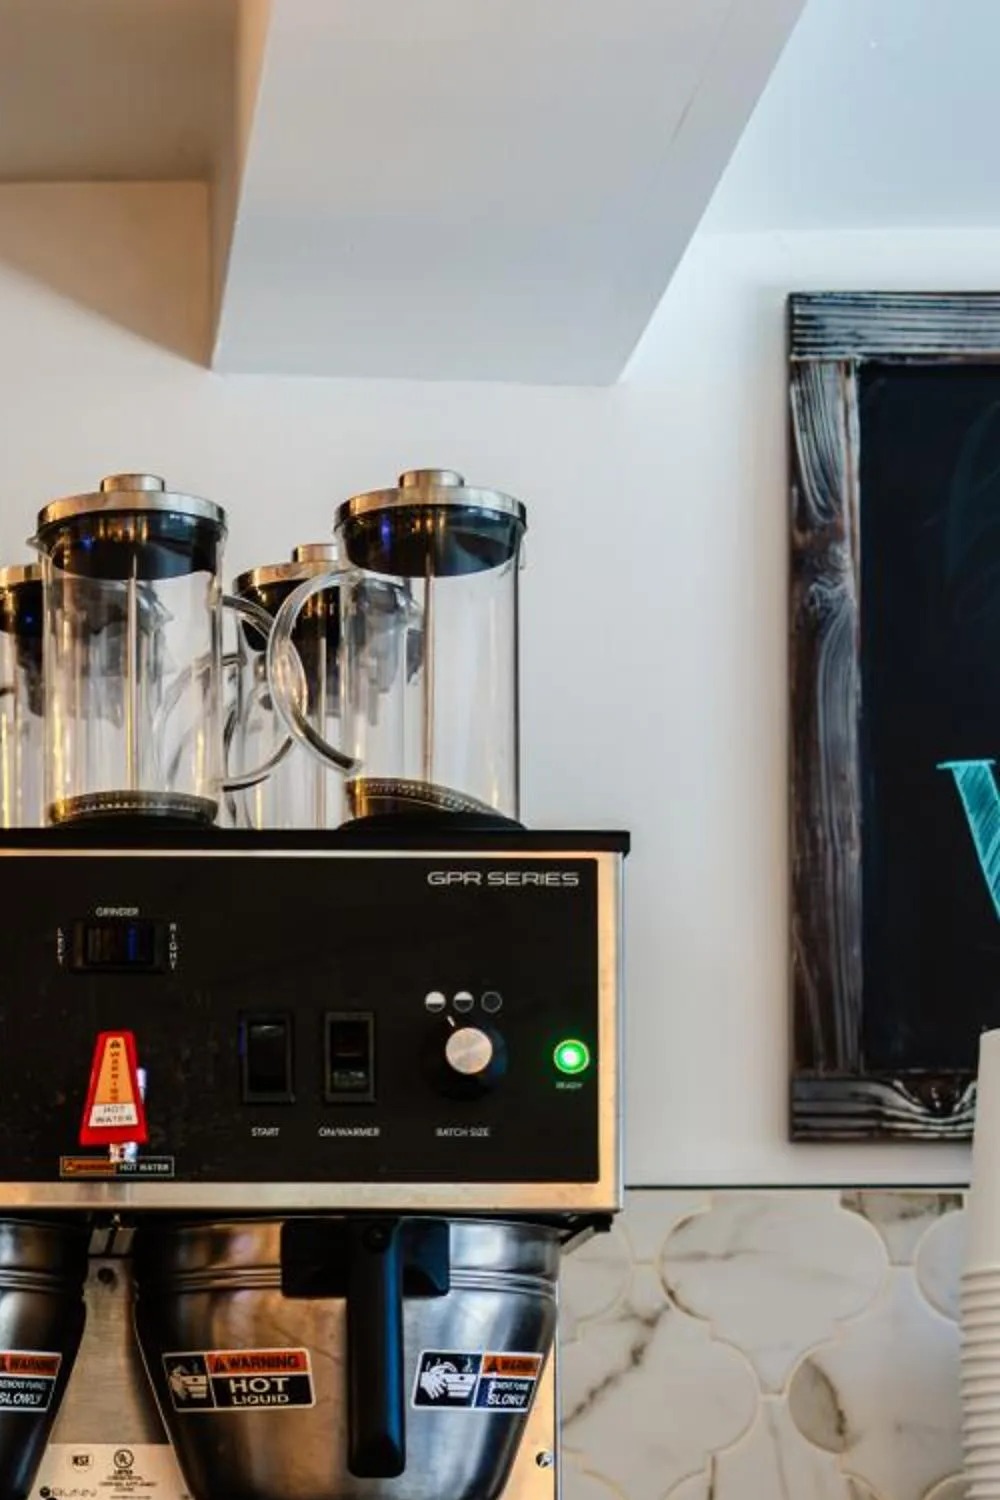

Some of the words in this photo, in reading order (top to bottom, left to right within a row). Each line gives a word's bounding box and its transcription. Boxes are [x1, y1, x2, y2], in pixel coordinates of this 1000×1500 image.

[427, 871, 482, 886] GPR
[487, 871, 580, 887] SERIES
[95, 907, 139, 917] GRINDER
[251, 1127, 280, 1137] START
[435, 1127, 468, 1137] BATCH
[469, 1127, 490, 1137] SIZE
[229, 1355, 296, 1369] WARNING
[229, 1377, 290, 1393] HOT
[231, 1393, 290, 1405] LIQUID
